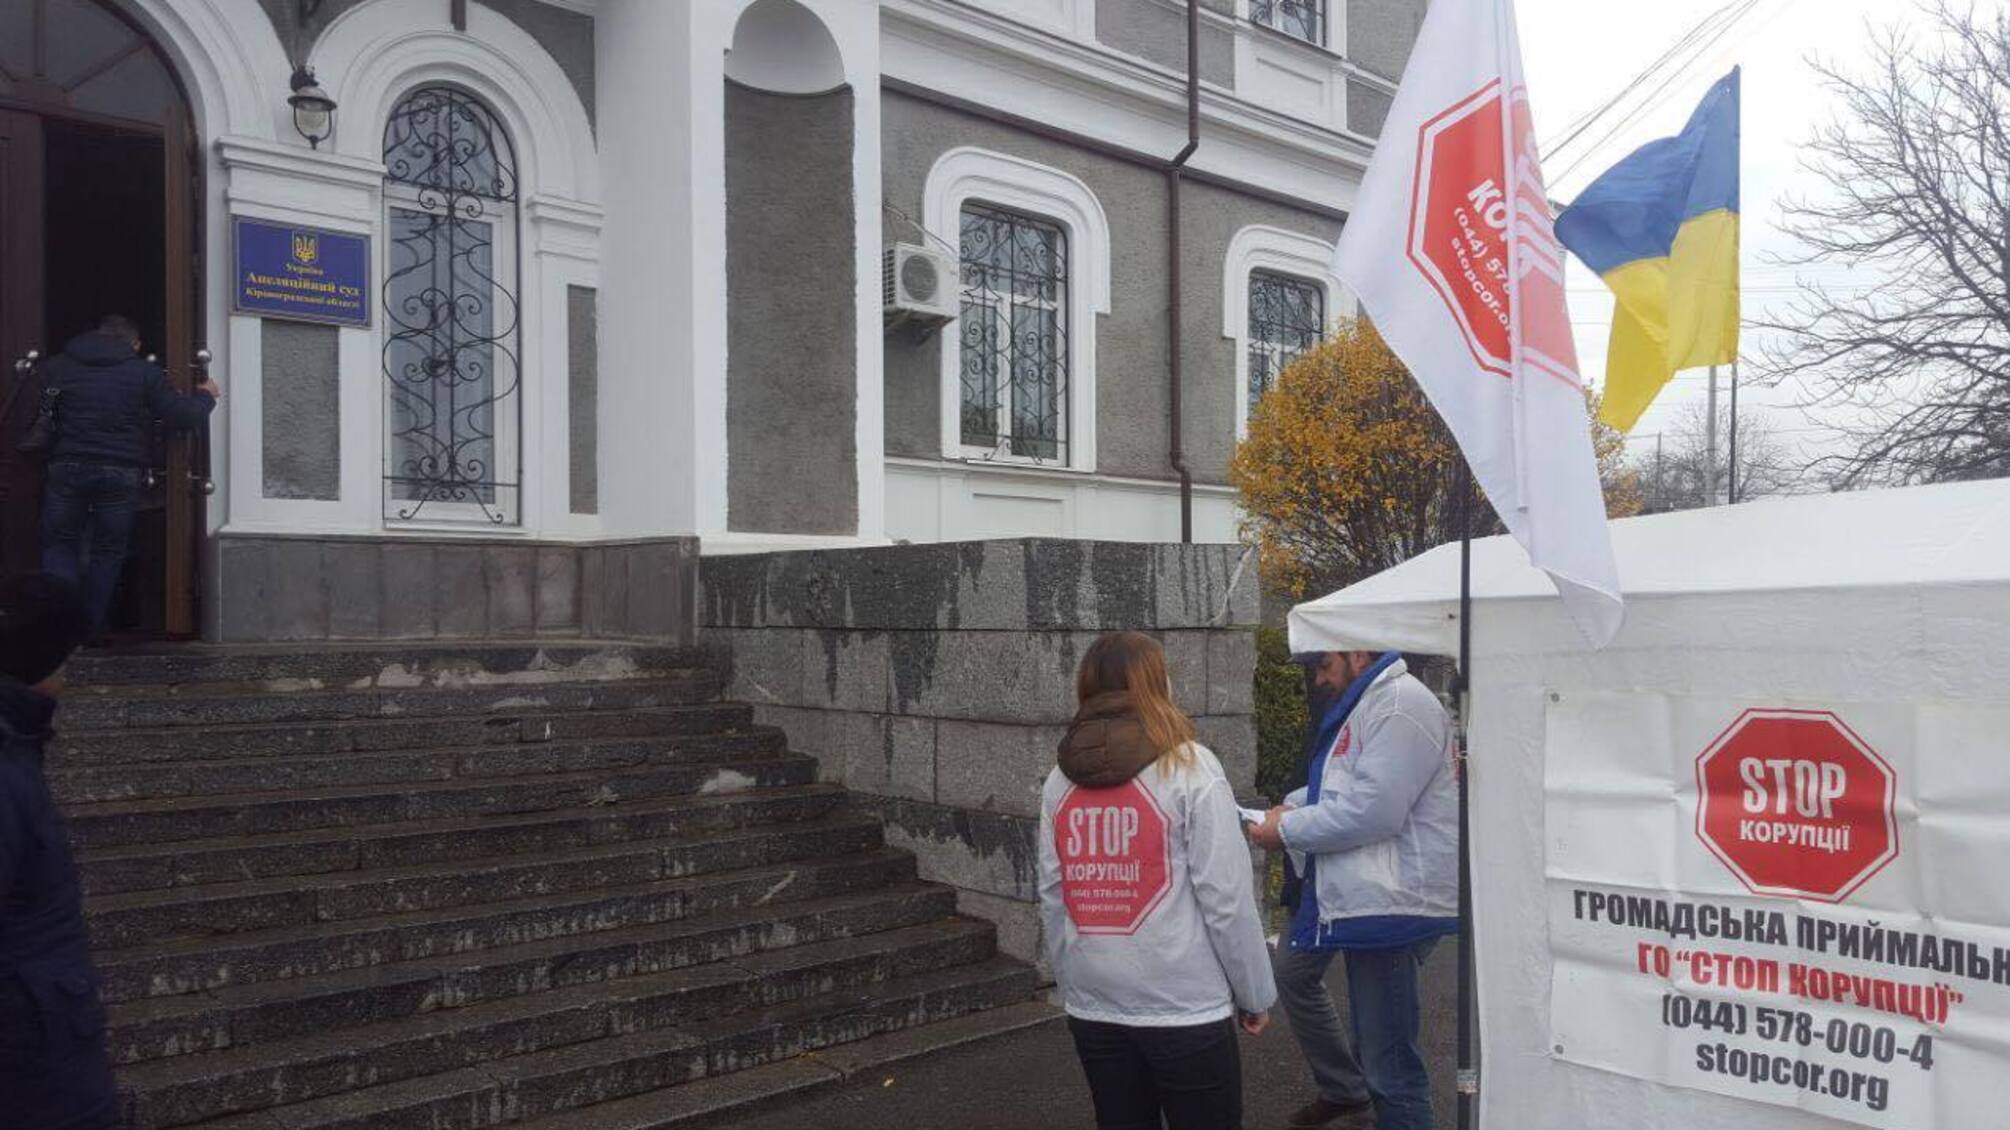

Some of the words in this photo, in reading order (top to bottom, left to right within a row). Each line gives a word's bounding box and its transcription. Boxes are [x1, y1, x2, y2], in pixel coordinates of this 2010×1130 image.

[1467, 179, 1510, 242] КО
[1738, 756, 1847, 818] STOP
[1066, 805, 1139, 857] STOP
[1739, 819, 1852, 854] КОРУПЦІЇ
[1066, 859, 1140, 885] КОРУПЦІЇ
[1573, 888, 1788, 947] ГРОМАДСЬКА
[1796, 914, 2010, 986] ПРИЙМАЛЬН
[1637, 942, 1670, 977] ГО
[1662, 993, 1748, 1036] (044)
[1756, 1006, 1934, 1070] 578-000-4
[1696, 1042, 1889, 1111] stopcor.org
